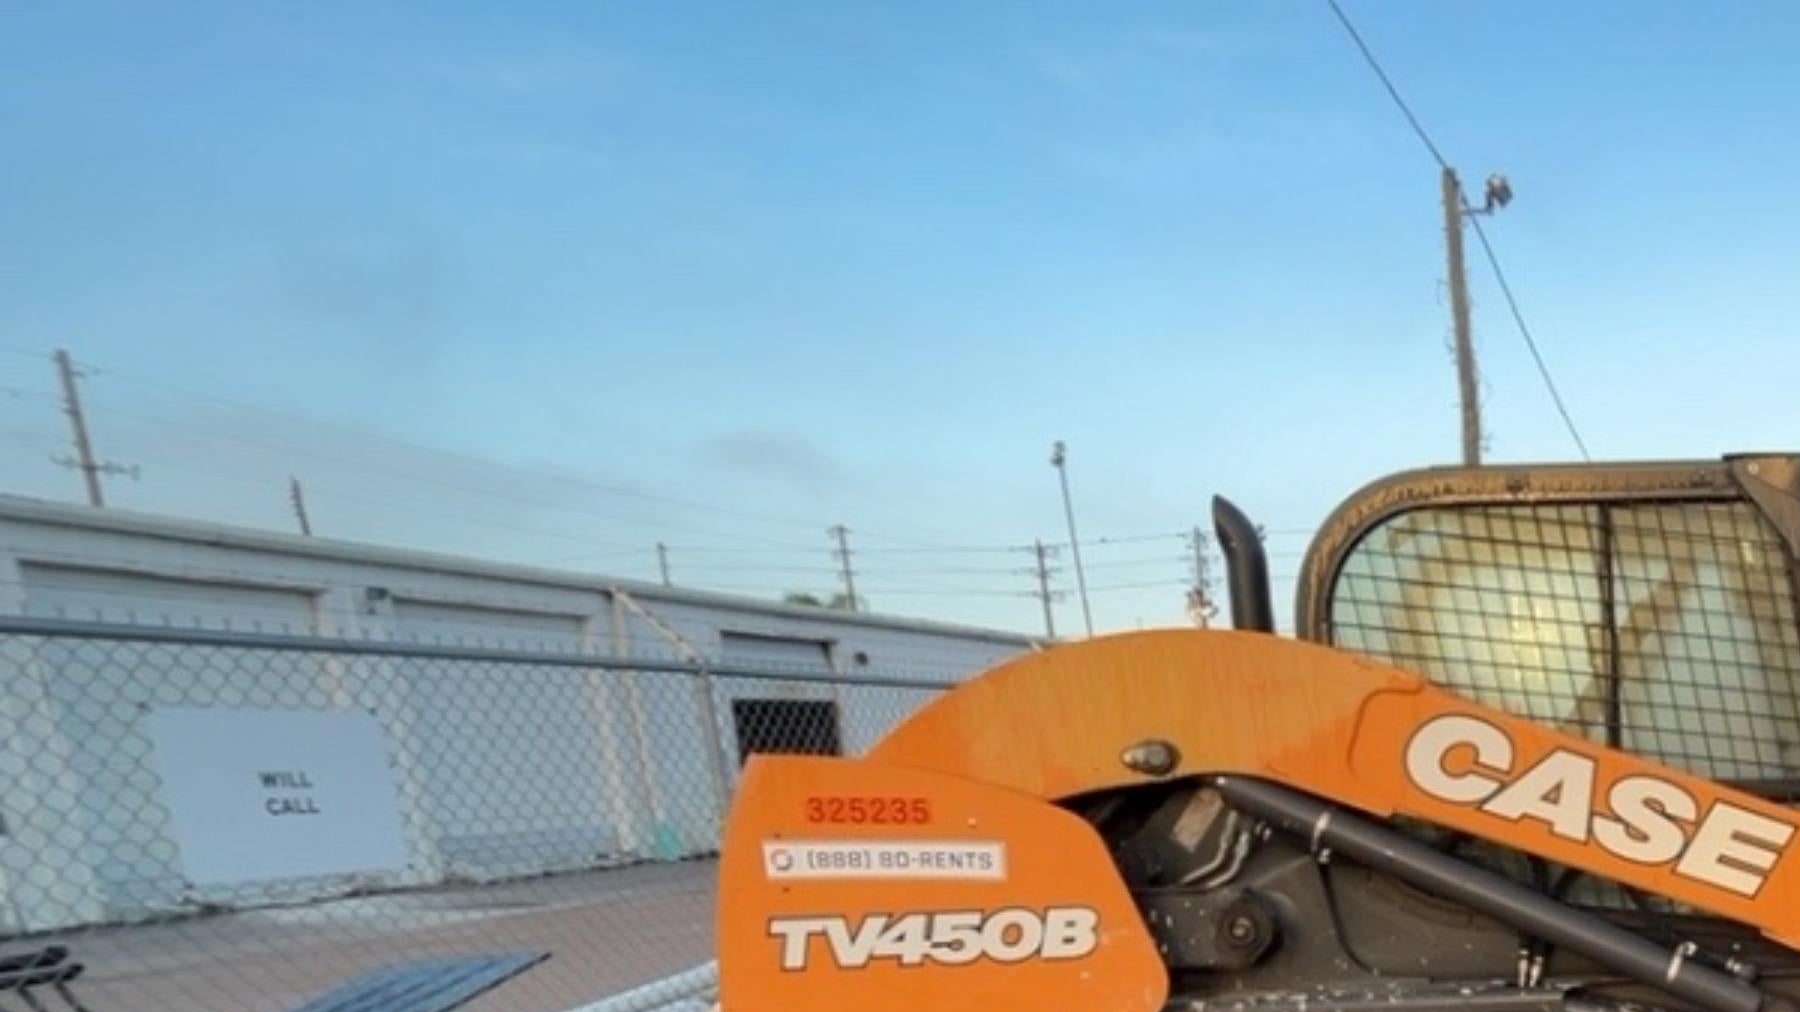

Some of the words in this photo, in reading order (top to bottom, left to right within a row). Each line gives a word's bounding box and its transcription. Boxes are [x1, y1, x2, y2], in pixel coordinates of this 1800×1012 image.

[258, 771, 313, 788] WILL
[265, 797, 320, 815] CALL
[807, 798, 931, 824] 325235
[1405, 713, 1799, 900] CASE
[806, 851, 872, 870] (888)
[878, 851, 994, 871] 80-RENTS
[768, 906, 1099, 971] TV450B
